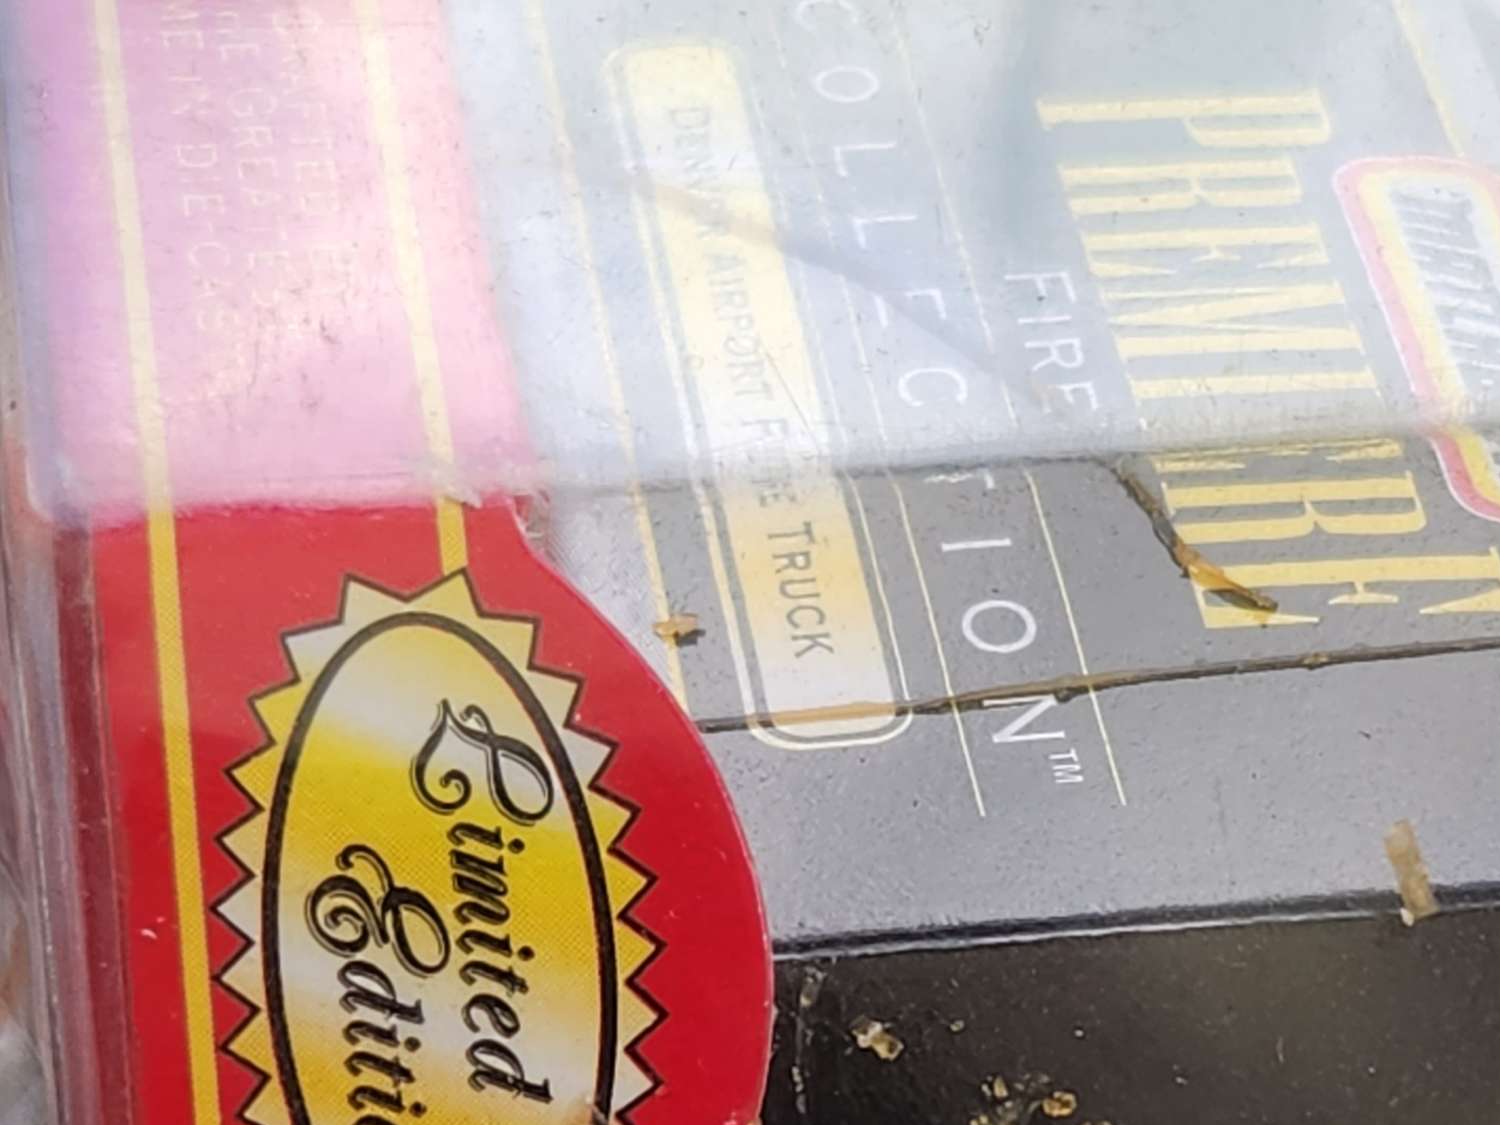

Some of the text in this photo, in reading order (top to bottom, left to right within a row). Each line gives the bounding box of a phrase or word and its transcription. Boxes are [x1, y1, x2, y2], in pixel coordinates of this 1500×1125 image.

[707, 252, 774, 402] AIRPORT
[766, 520, 836, 660] TRUCK
[410, 697, 556, 1104] Limited
